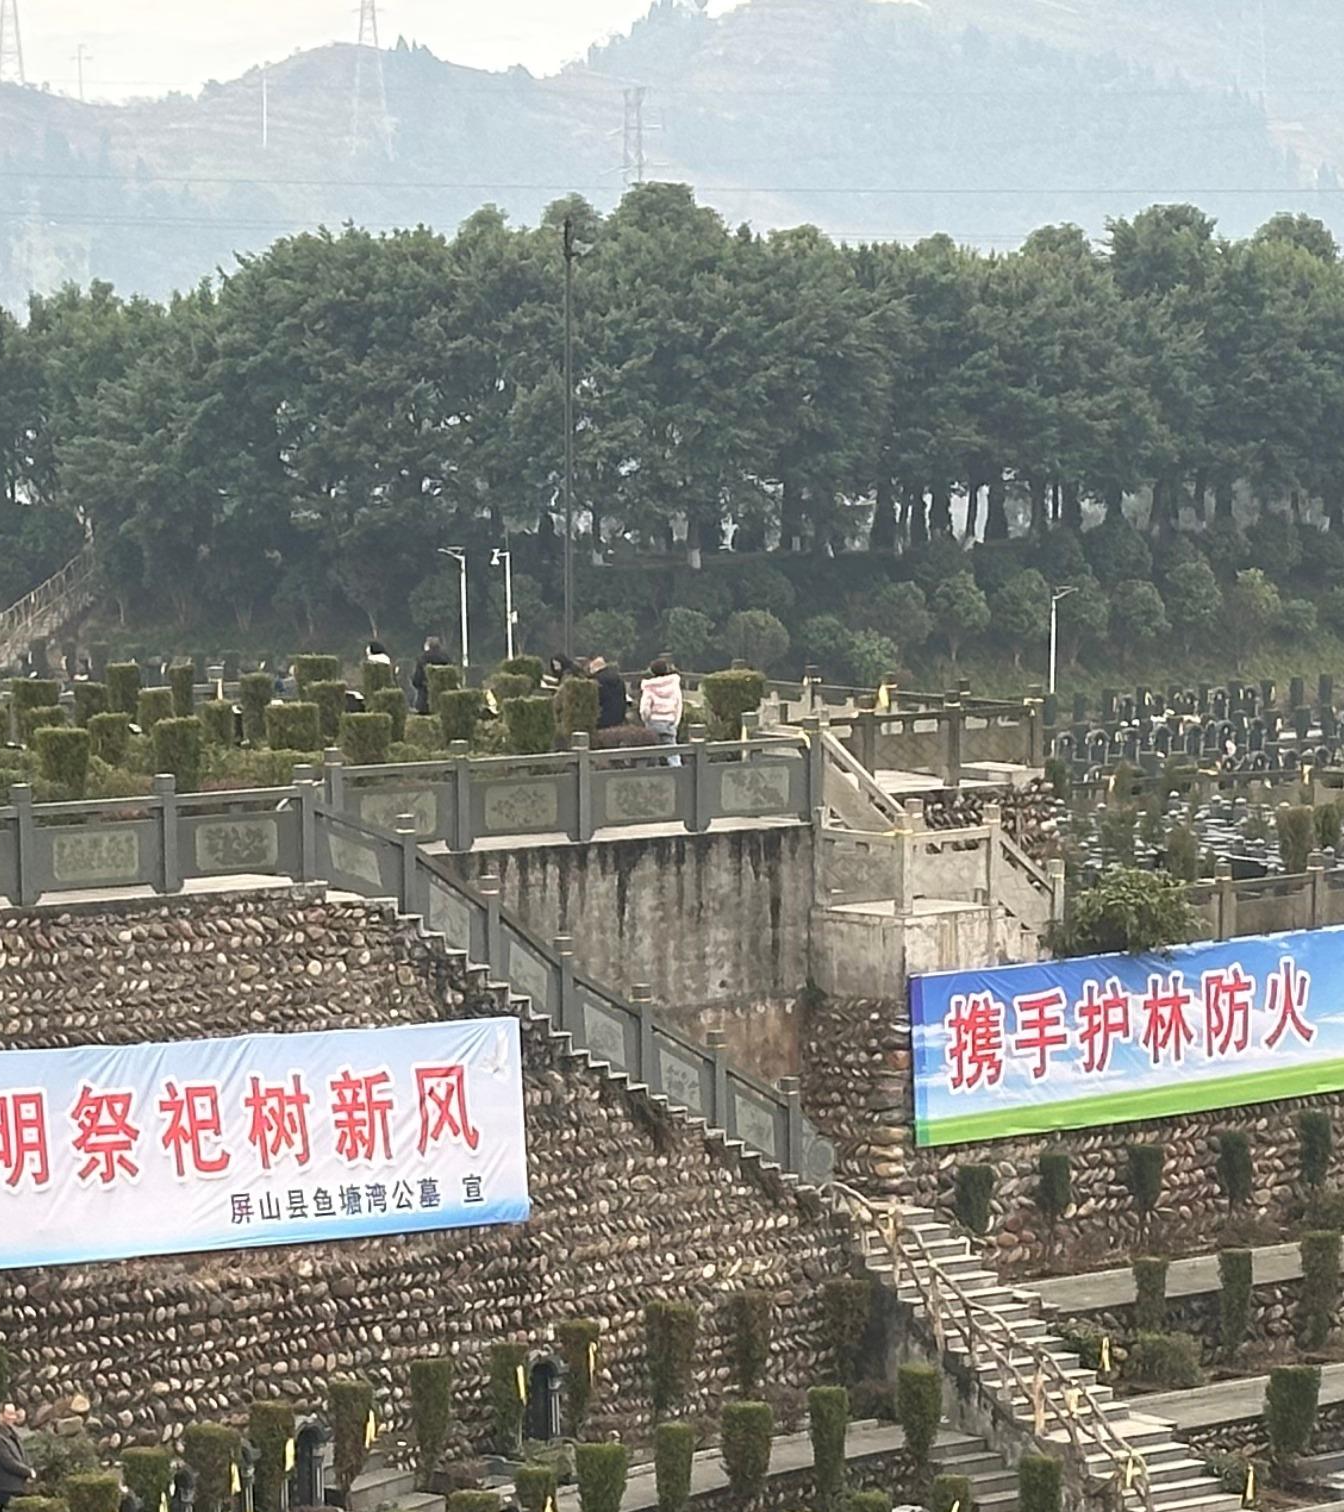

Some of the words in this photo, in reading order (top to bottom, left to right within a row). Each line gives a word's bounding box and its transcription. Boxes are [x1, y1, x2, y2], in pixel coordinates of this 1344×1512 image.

[946, 958, 1314, 1091] 携手护林防火
[231, 1176, 441, 1224] 屏山县鱼塘湾公墓
[462, 1174, 484, 1203] 宣
